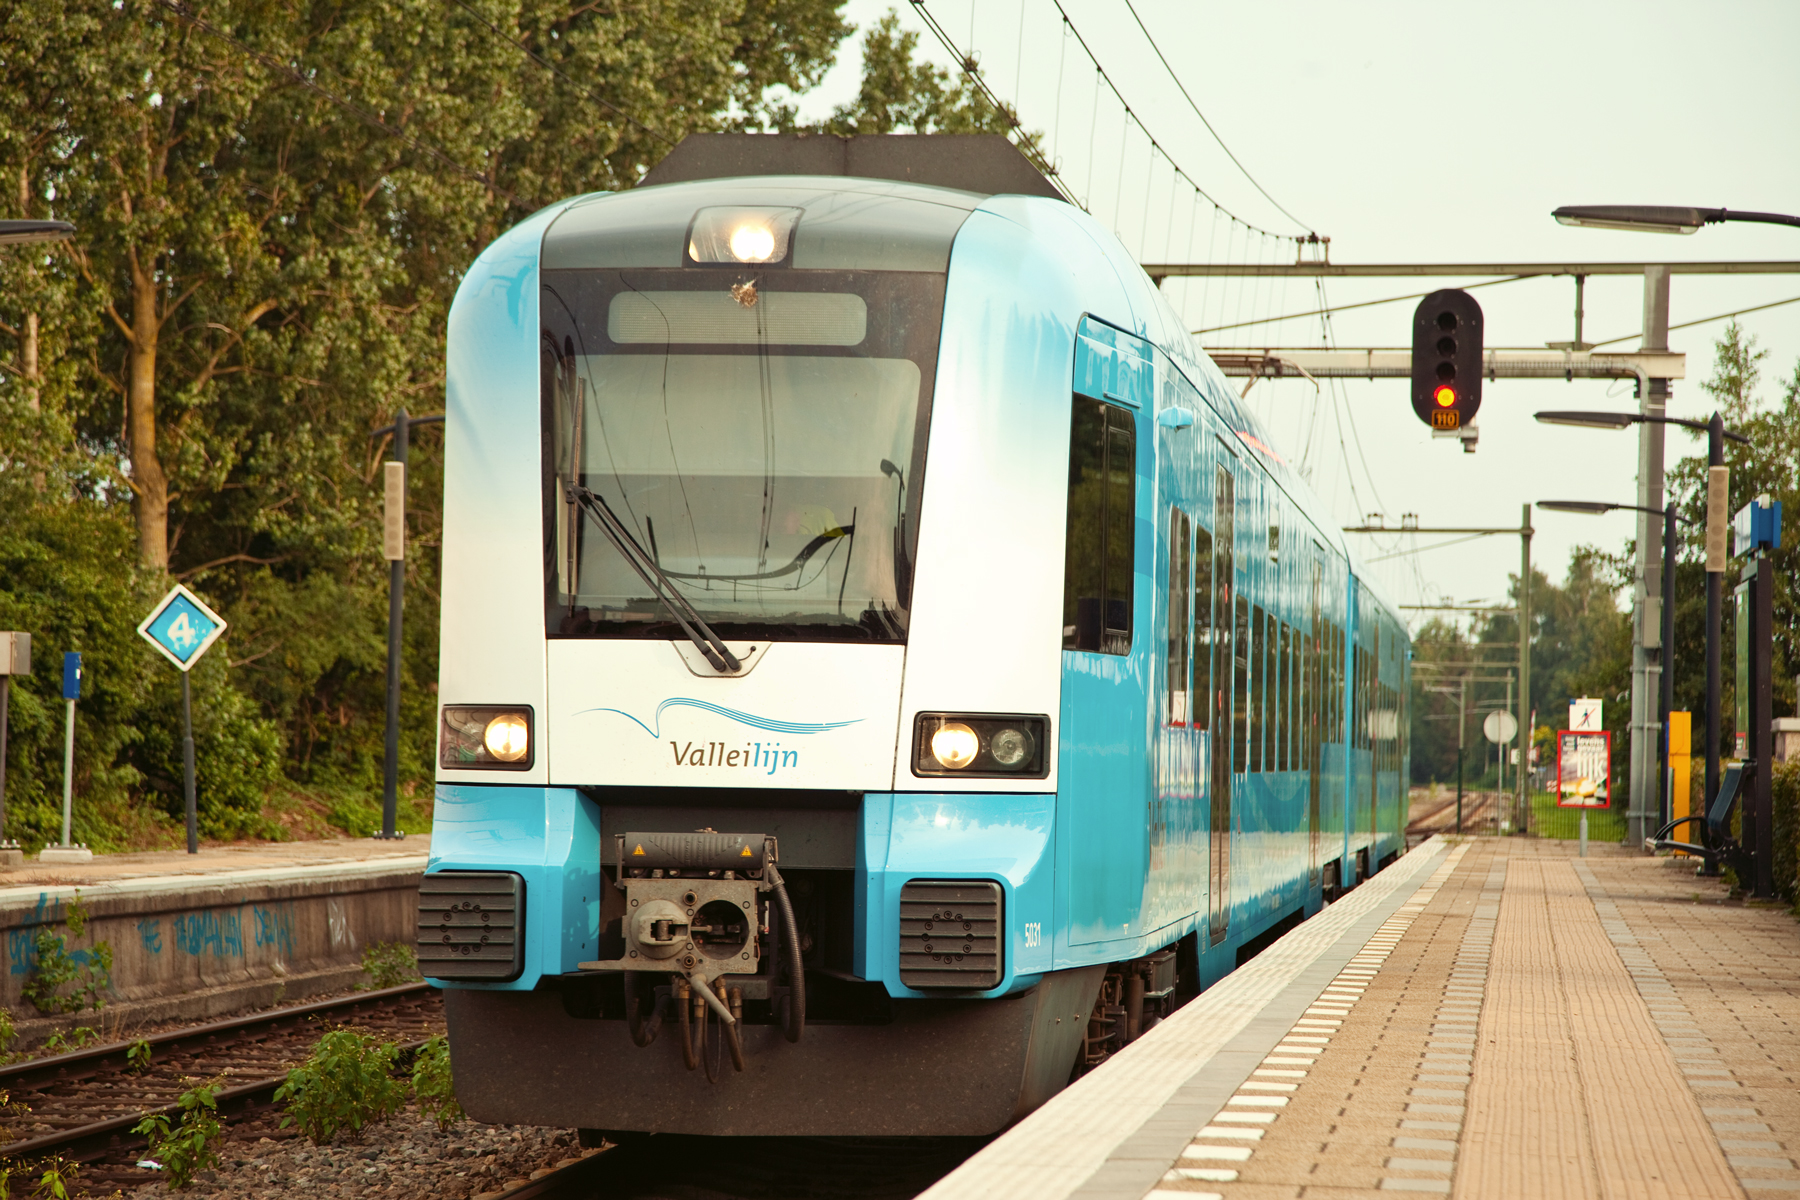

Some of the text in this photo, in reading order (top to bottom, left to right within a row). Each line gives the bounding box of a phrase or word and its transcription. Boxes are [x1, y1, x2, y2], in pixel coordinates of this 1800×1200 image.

[1436, 413, 1455, 426] 110
[167, 612, 196, 648] 4
[669, 740, 799, 776] Valleilijn
[1577, 753, 1605, 782] lijk
[1024, 921, 1042, 949] 5031
